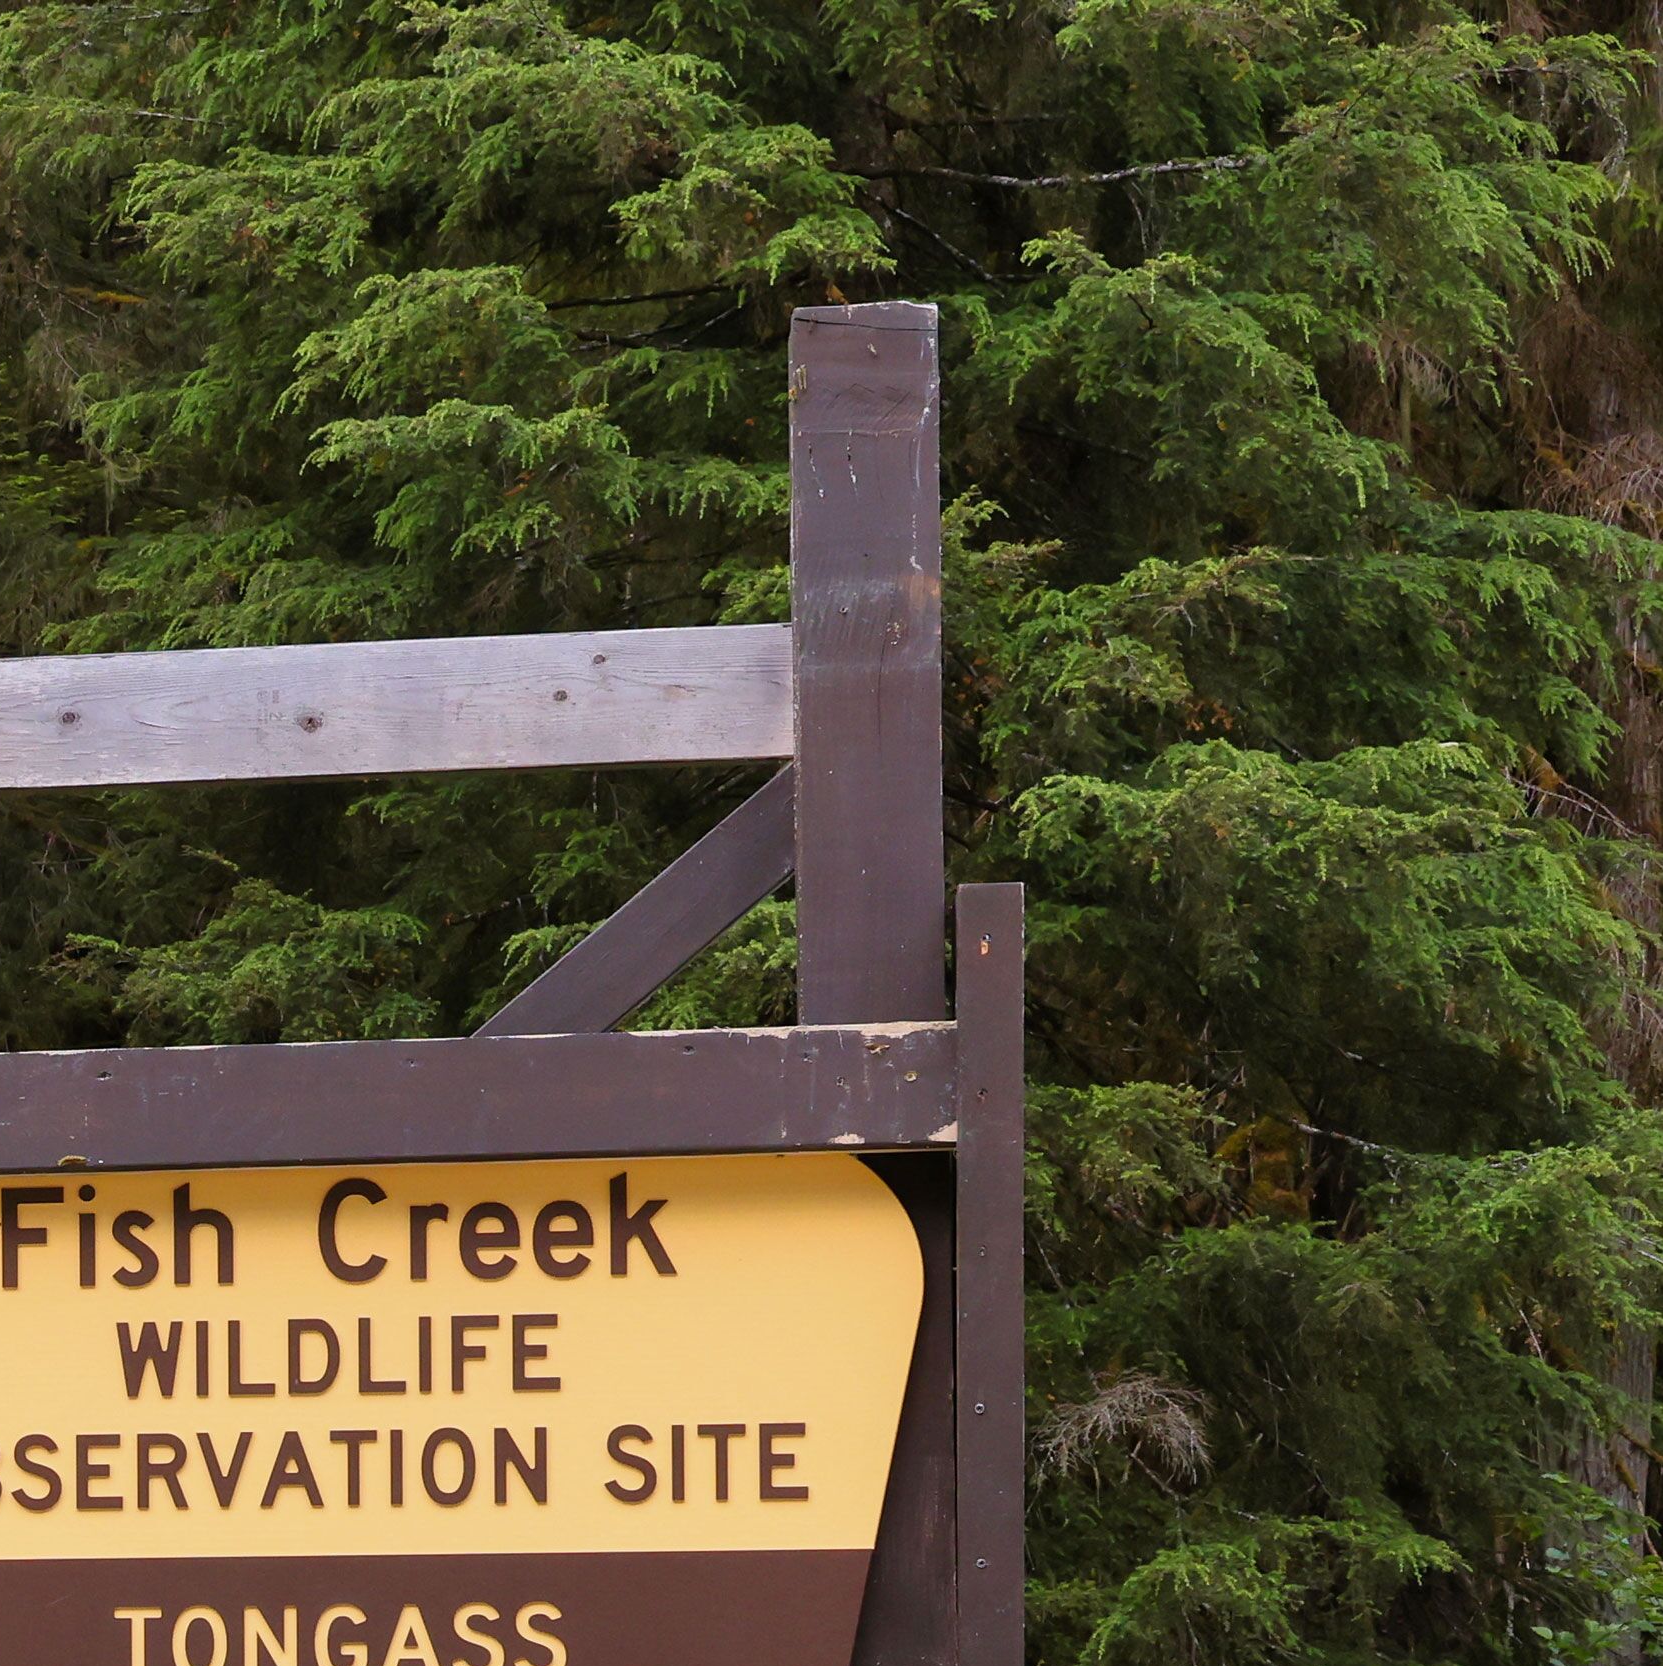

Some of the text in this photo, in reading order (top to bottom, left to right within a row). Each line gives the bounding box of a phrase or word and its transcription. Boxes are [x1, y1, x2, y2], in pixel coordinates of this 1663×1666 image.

[0, 1171, 678, 1291] Fish Creek
[115, 1313, 562, 1400] WILDLIFE
[604, 1422, 810, 1506] SITE
